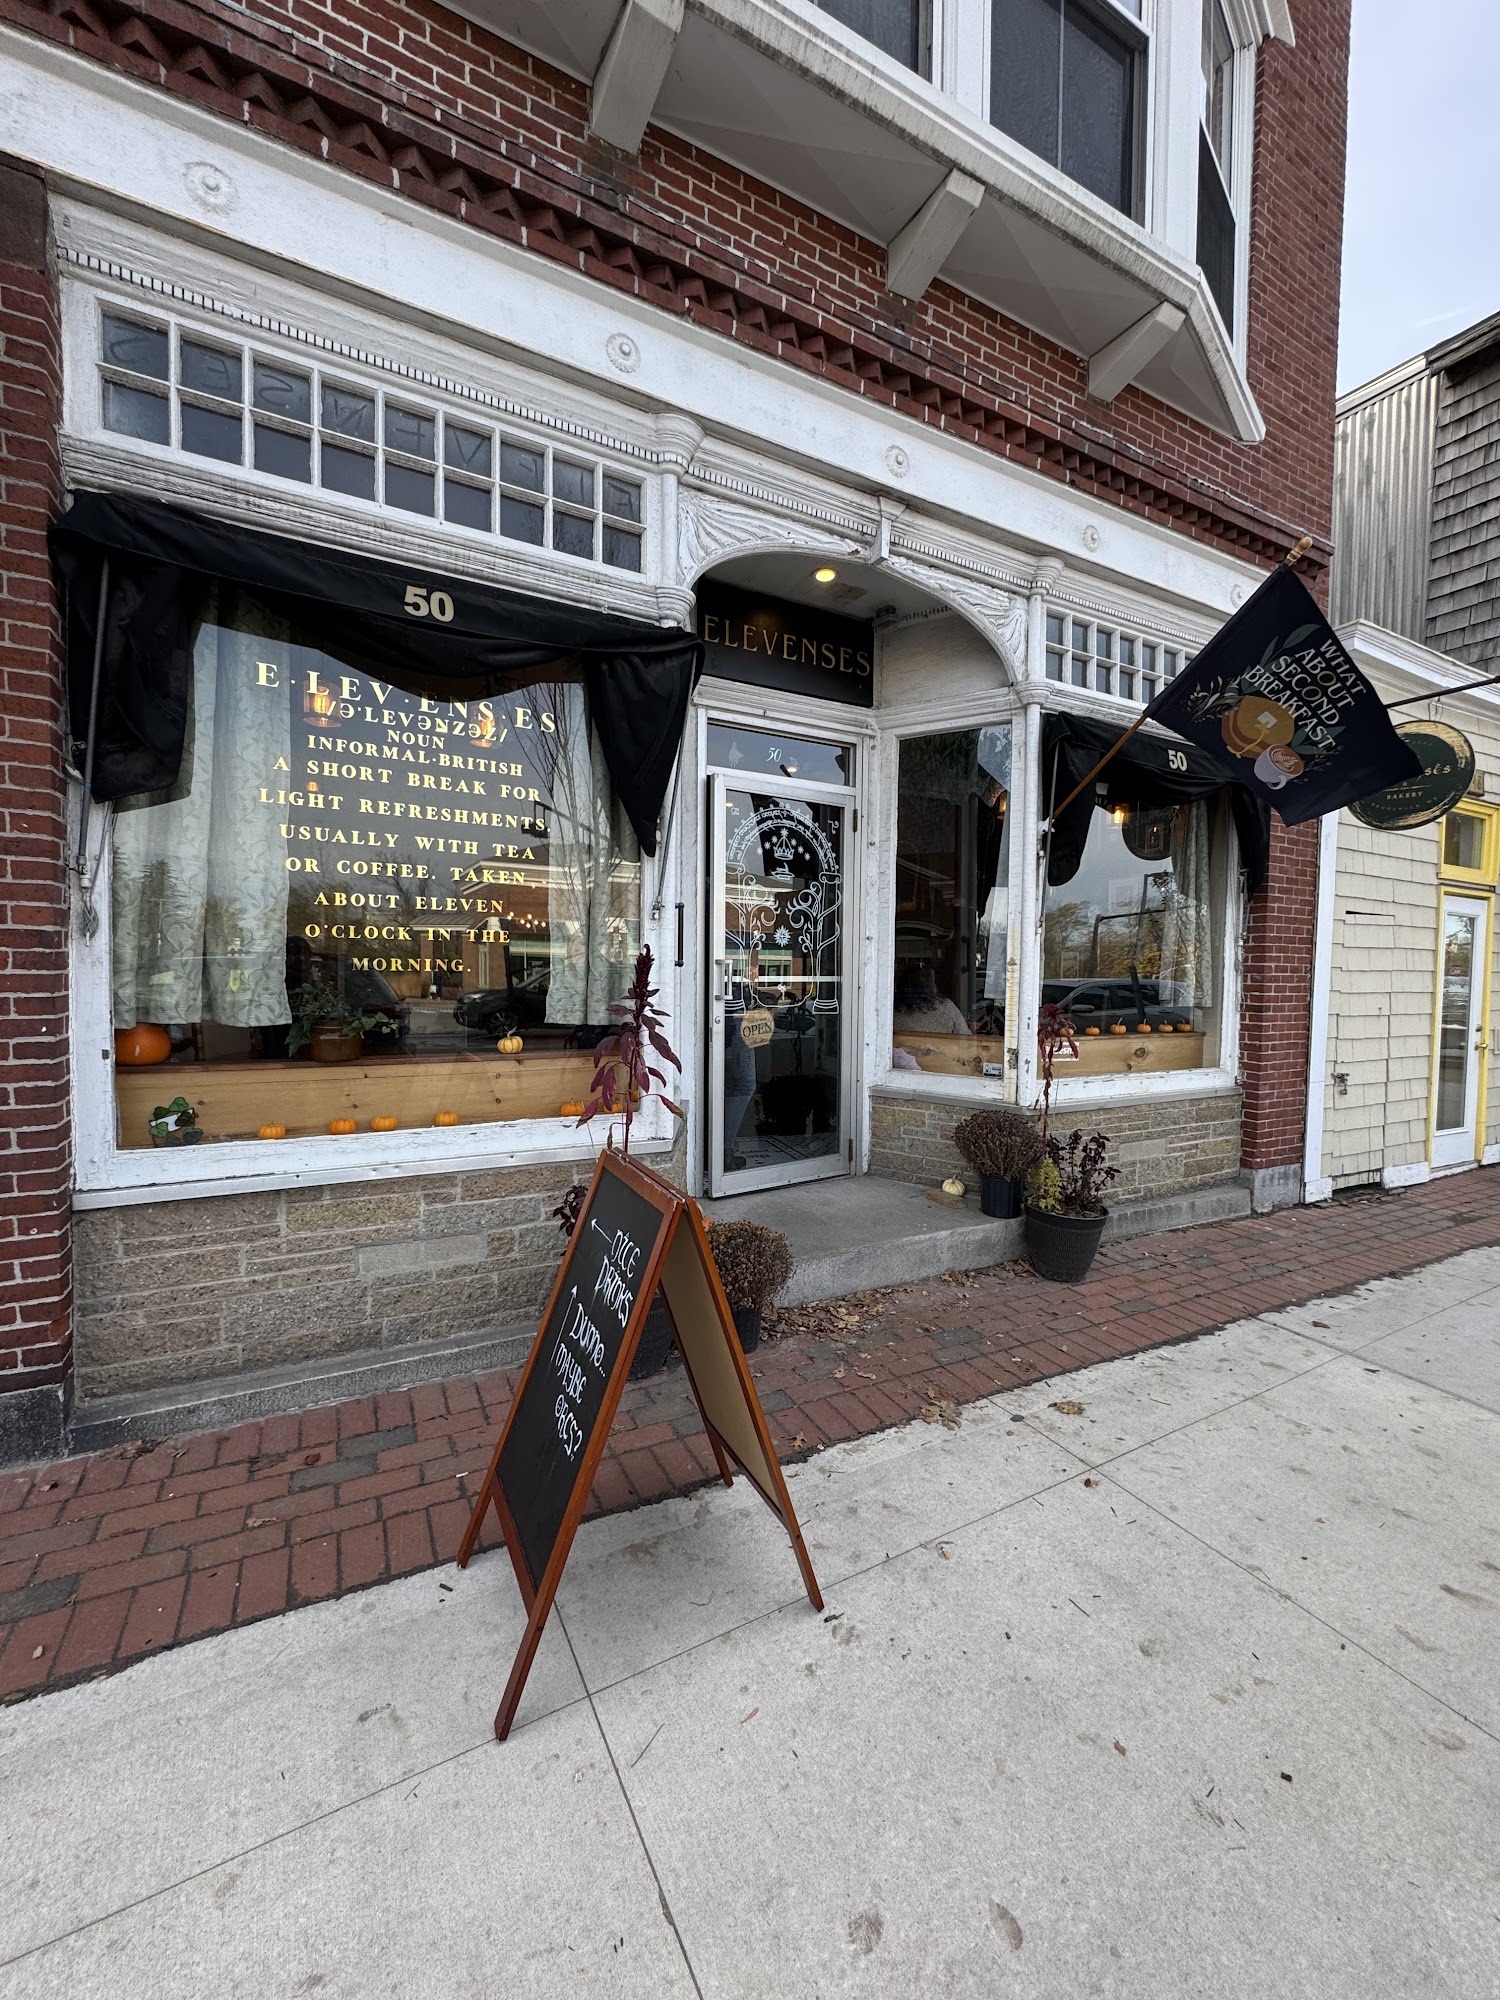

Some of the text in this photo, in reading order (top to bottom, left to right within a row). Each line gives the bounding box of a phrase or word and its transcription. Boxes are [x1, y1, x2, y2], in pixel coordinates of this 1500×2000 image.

[404, 585, 454, 622] 50
[704, 615, 870, 676] ELEVENSES
[1295, 648, 1355, 708] ABOUT
[1320, 639, 1366, 694] WHAT
[1271, 656, 1339, 724] SECOND
[1245, 664, 1336, 751] BREAKFAST
[387, 729, 445, 749] NOUN
[766, 747, 782, 762] 50
[1168, 749, 1187, 771] 50
[273, 757, 541, 802] A SHORT BREAK FOR
[259, 788, 344, 810] LIGHT
[1386, 791, 1423, 800] BAKERY
[279, 824, 536, 860] USUALLY WITH TEA
[285, 857, 526, 885] OR COFFEE. TAKEN
[314, 892, 504, 913] ABOUT ELEVEN
[305, 923, 510, 943] O'CLOCK IN THE
[352, 957, 471, 973] MORNING.
[742, 1021, 772, 1039] OPEN
[556, 1342, 586, 1403] MAYBE
